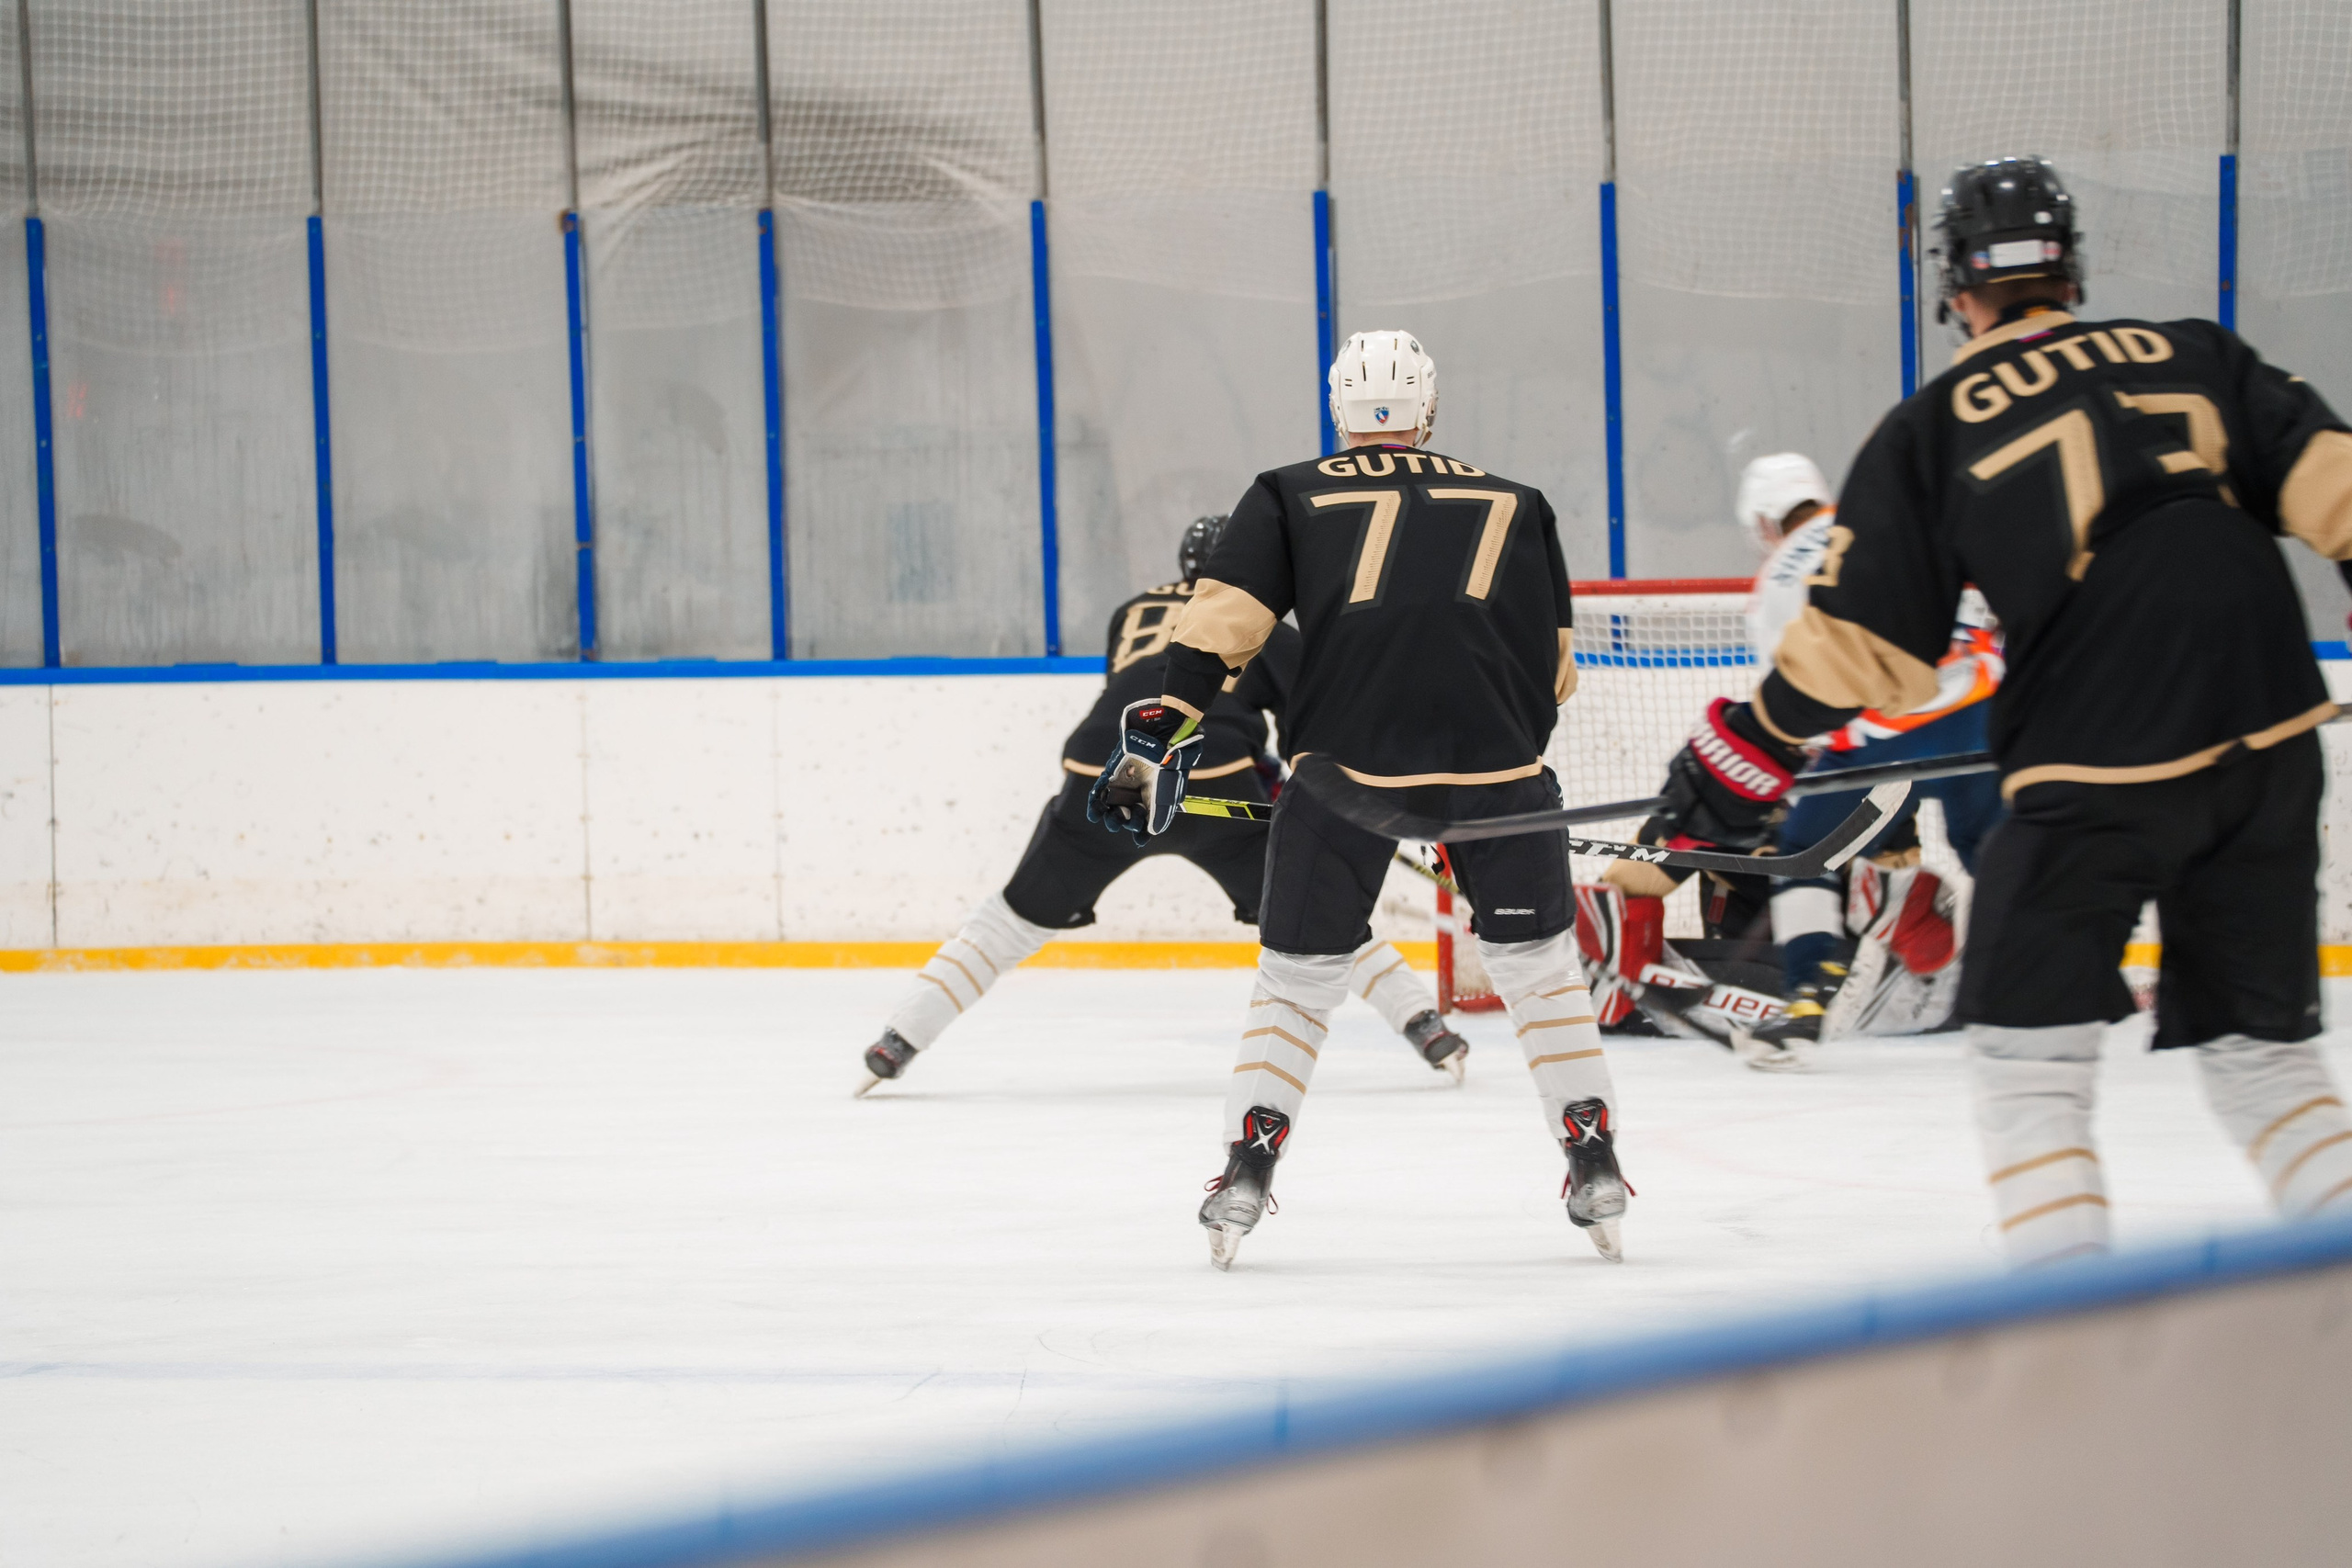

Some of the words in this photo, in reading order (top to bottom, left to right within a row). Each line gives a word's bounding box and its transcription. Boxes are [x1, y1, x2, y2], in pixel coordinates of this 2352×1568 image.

[1951, 327, 2175, 423] GUTID
[1317, 453, 1487, 477] GUTID
[1310, 488, 1518, 604] 77
[1129, 735, 1156, 749] CCM
[1691, 724, 1781, 796] RRIOR
